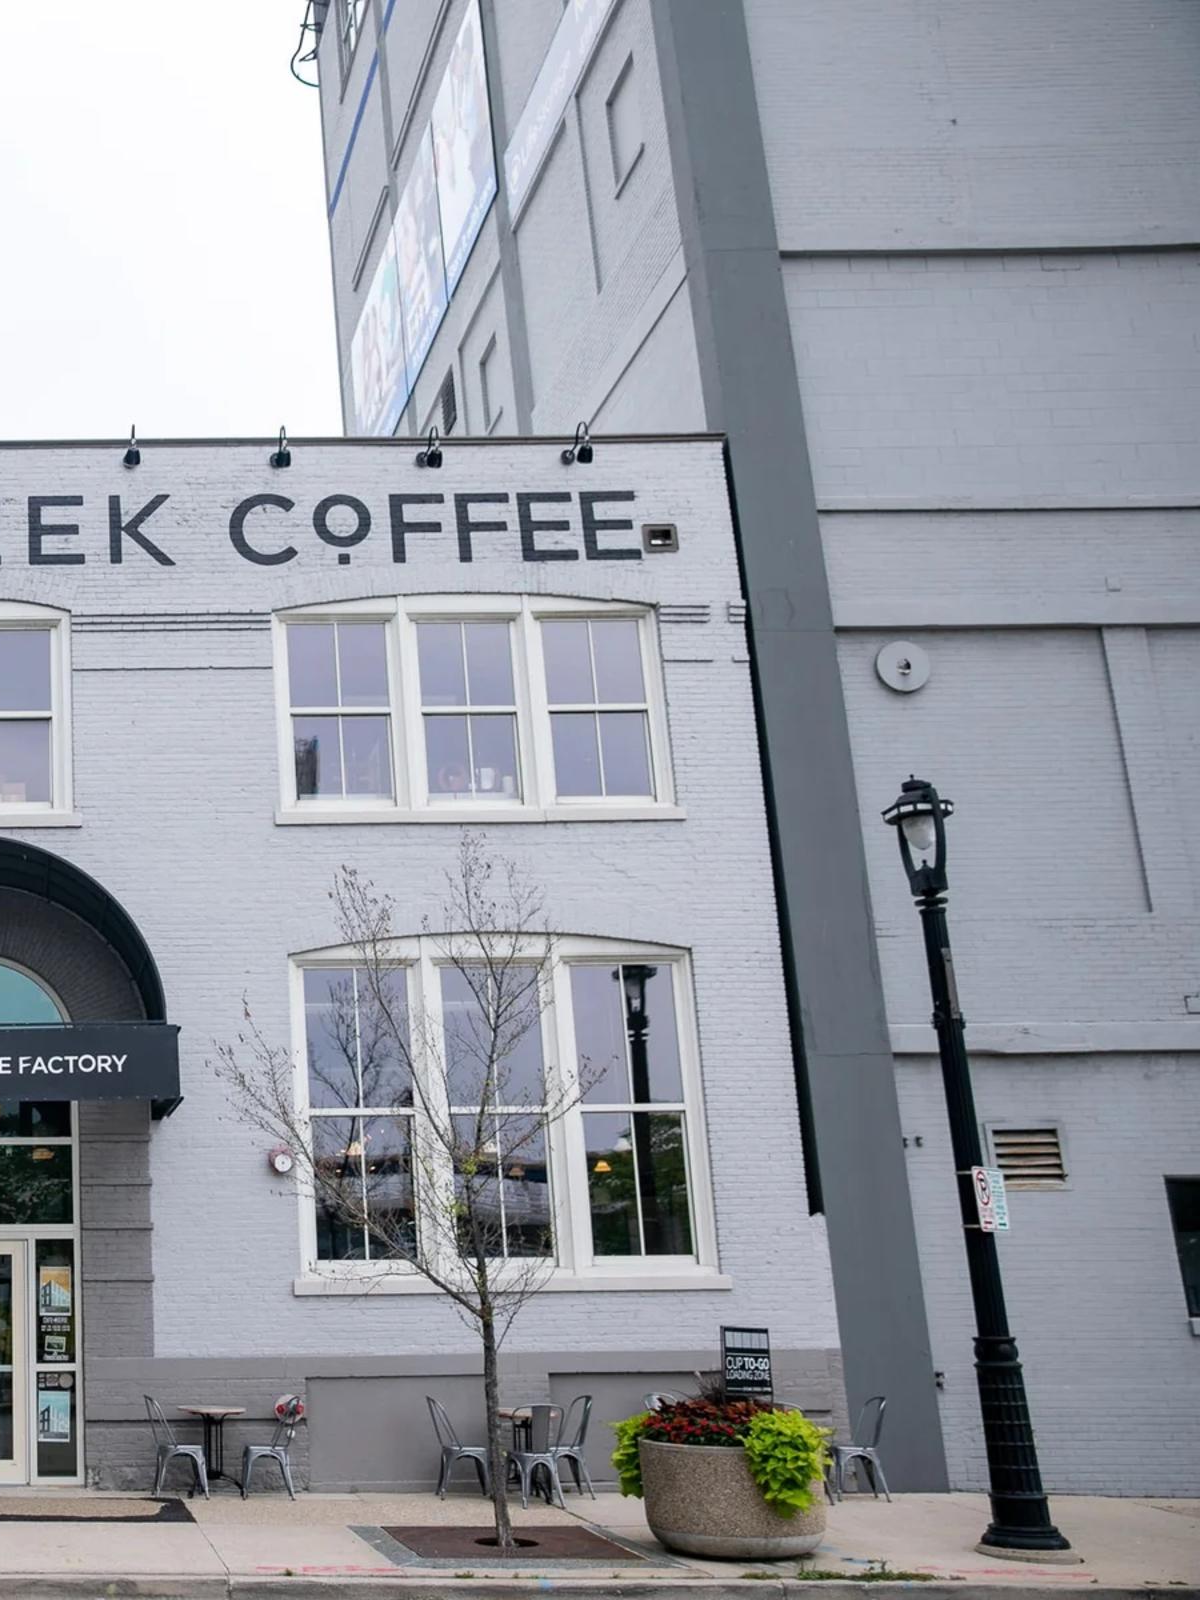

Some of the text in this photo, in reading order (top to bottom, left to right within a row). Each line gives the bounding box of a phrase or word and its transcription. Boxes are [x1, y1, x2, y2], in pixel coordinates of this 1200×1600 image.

[228, 490, 642, 566] COFFEE
[18, 1054, 128, 1075] FACTORY
[726, 1357, 770, 1370] CUP TO-GO
[726, 1369, 771, 1381] LOADING ZONE
